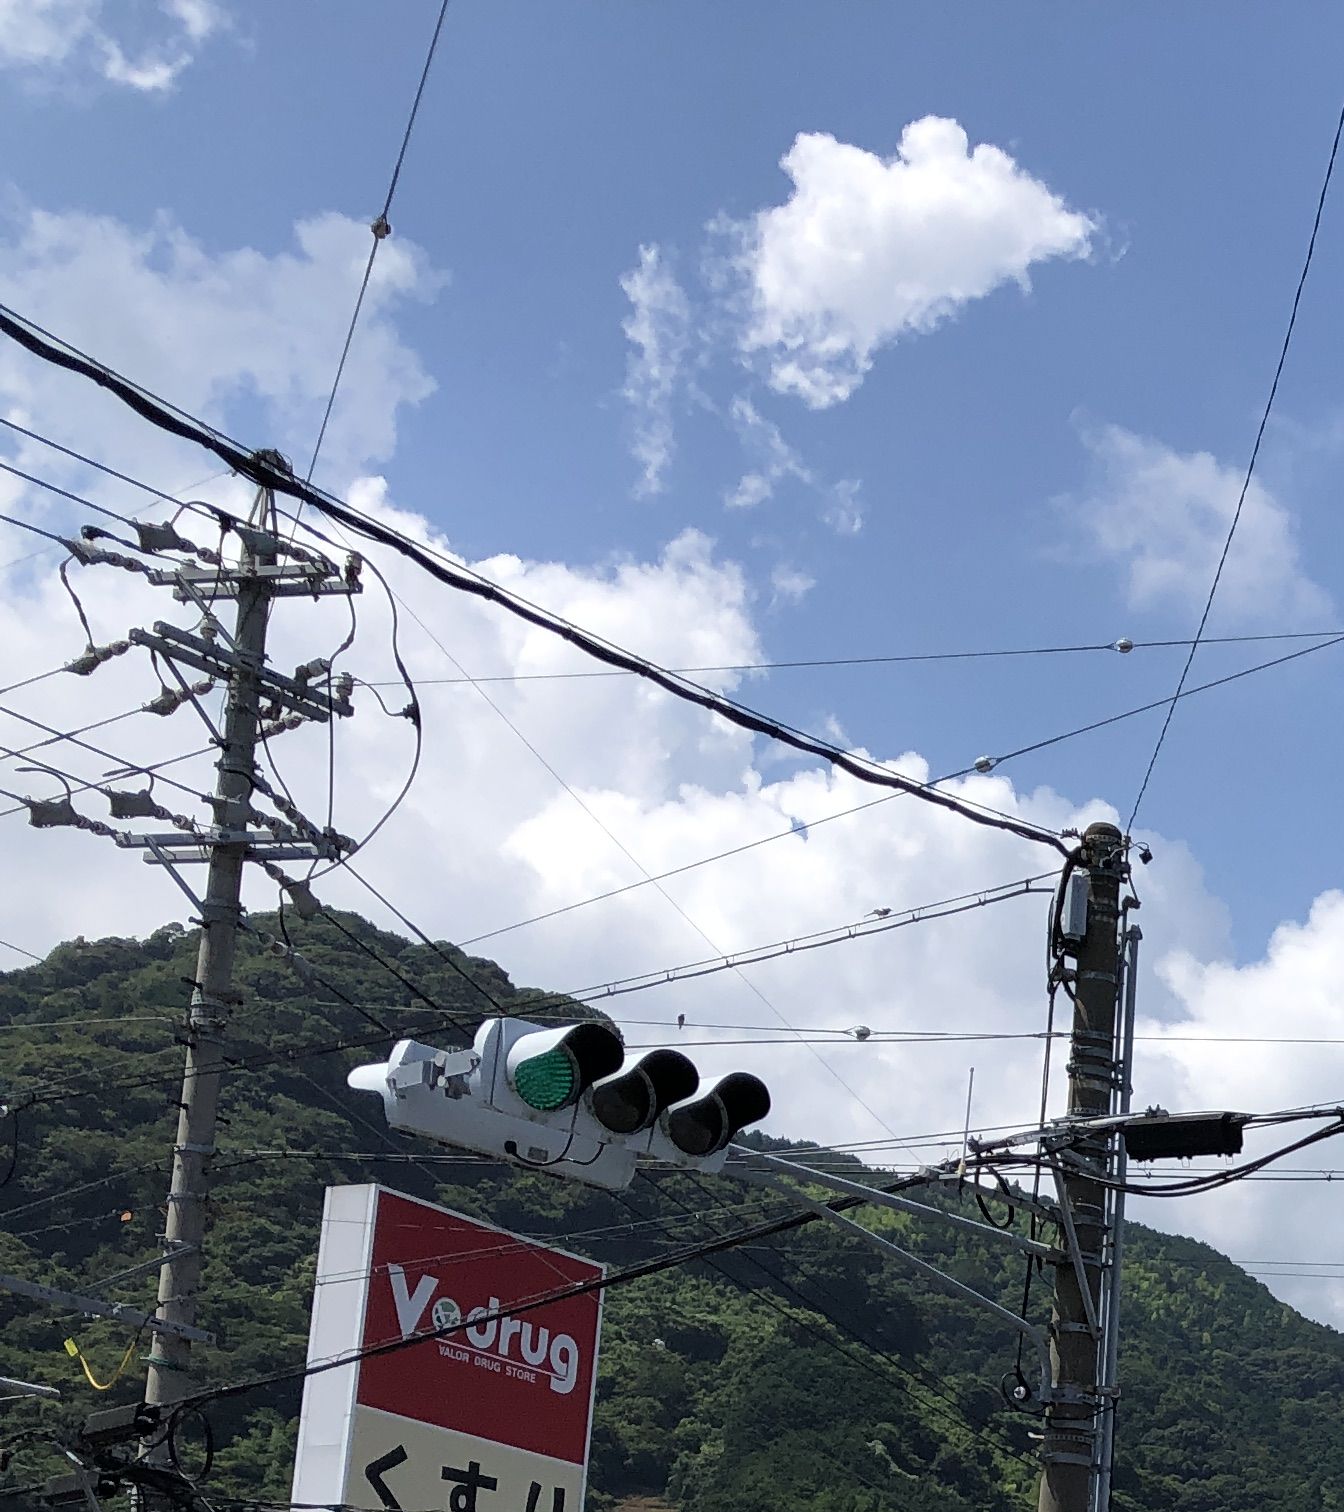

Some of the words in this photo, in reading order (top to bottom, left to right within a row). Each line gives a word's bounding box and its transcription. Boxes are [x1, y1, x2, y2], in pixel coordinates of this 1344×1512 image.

[438, 1345, 469, 1363] VALOR
[474, 1354, 501, 1373] DRUG
[505, 1366, 537, 1384] STORE
